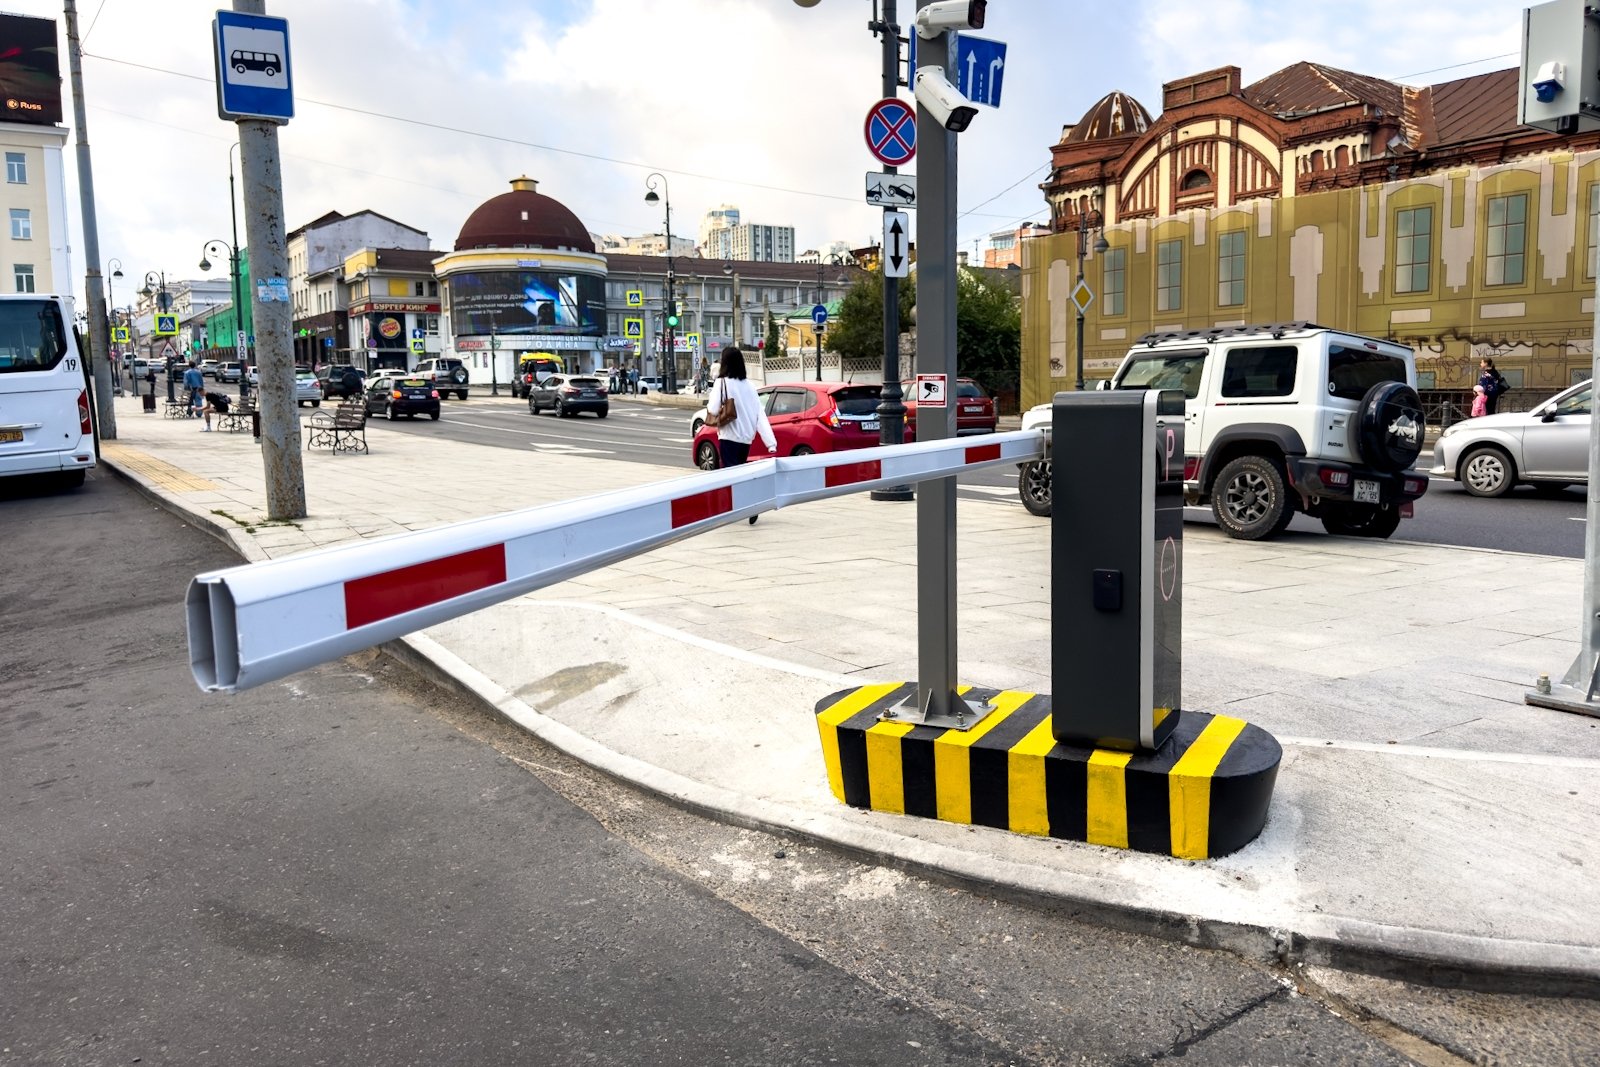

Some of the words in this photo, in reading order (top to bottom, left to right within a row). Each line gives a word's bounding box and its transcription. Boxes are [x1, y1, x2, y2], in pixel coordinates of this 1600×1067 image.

[20, 101, 42, 110] Russ
[238, 332, 246, 359] СТОП
[65, 359, 76, 371] 19
[1166, 429, 1175, 481] P
